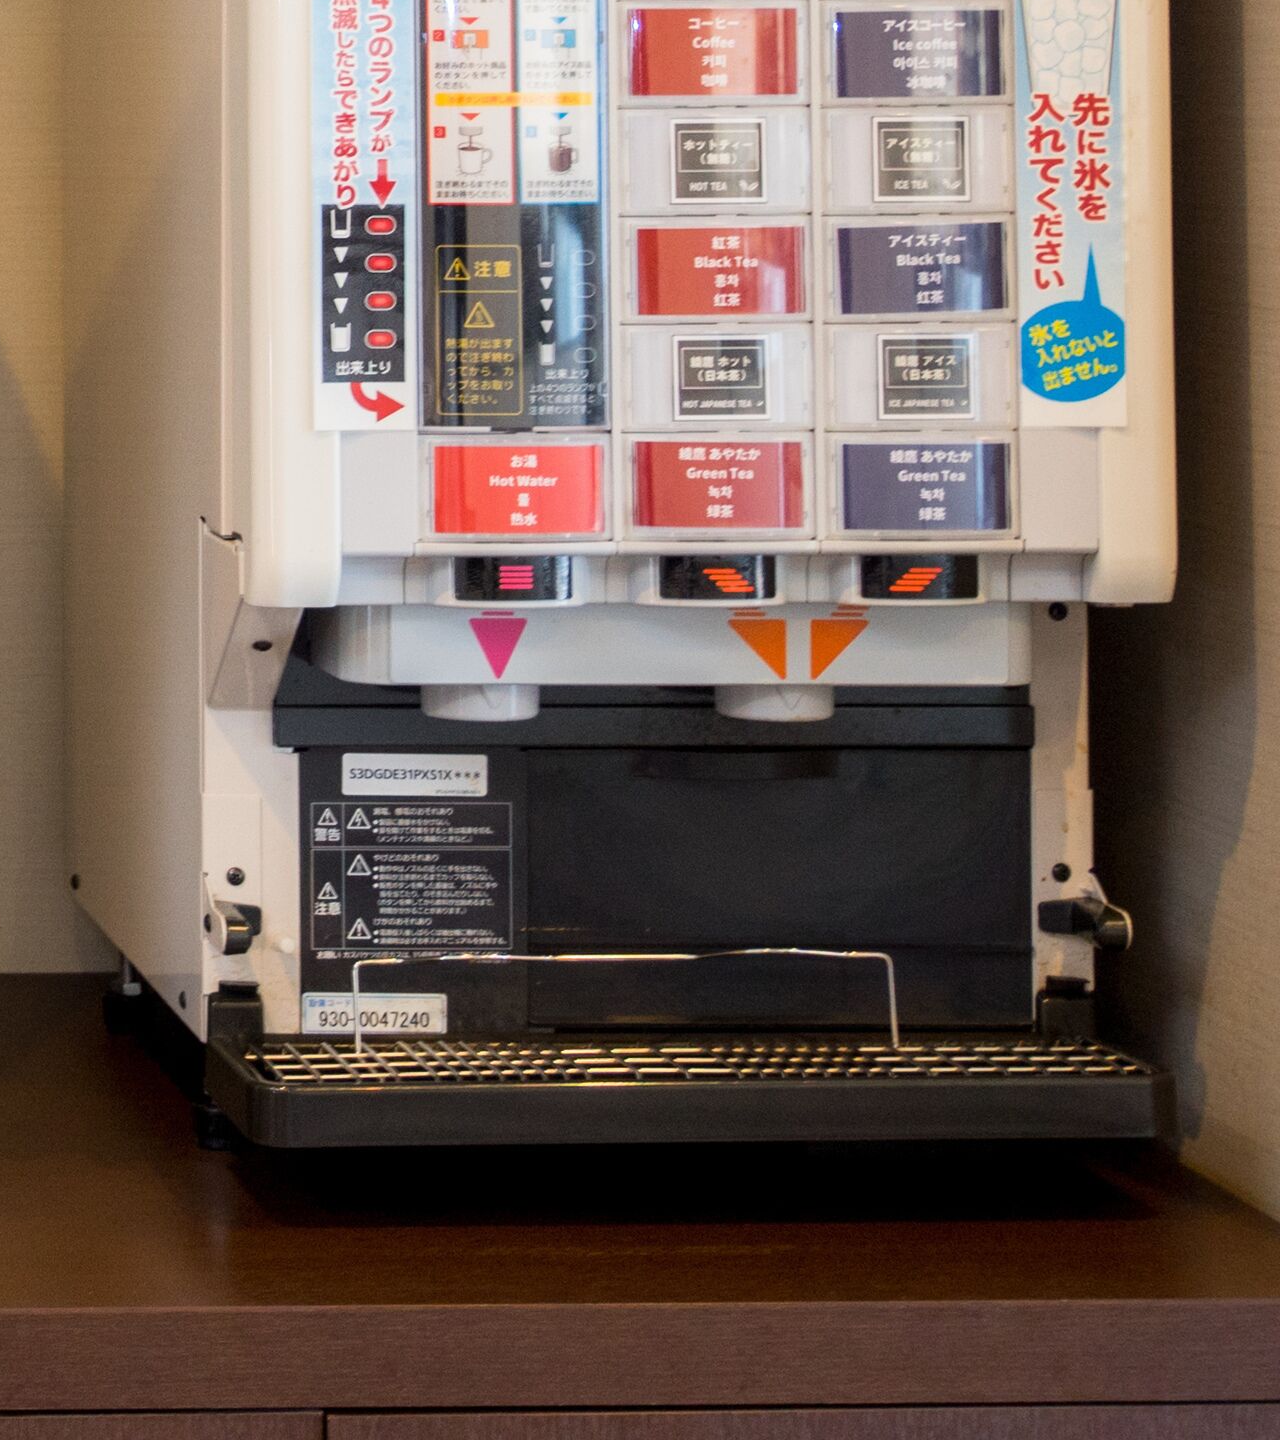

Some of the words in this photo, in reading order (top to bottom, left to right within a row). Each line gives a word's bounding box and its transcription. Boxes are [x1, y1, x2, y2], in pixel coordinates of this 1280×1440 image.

[688, 17, 739, 30] コーヒー
[882, 20, 966, 33] アイスコーヒー
[692, 36, 736, 49] Coffee
[893, 40, 913, 51] Ice
[916, 39, 957, 51] coffee
[683, 140, 754, 151] ホットティー
[886, 138, 955, 149] アイスティー
[1072, 94, 1110, 221] 先に氷を
[689, 182, 708, 192] HOT
[710, 181, 727, 191] TEA
[894, 180, 910, 190] ICE
[911, 180, 928, 190] TEA
[1028, 94, 1066, 290] 入れてください
[888, 235, 967, 248] アイスティー
[694, 256, 732, 268] Black
[735, 256, 759, 268] Tea
[896, 254, 934, 266] Black
[937, 253, 961, 264] Tea
[474, 261, 512, 278] 注意
[1029, 319, 1070, 347] 氷を
[1038, 330, 1119, 368] 入れないと
[718, 355, 752, 367] ホット
[923, 355, 957, 366] アイス
[335, 361, 392, 376] 出来上り
[545, 369, 589, 379] 出来上り
[709, 447, 761, 460] あやたか
[920, 450, 973, 463] あやたか
[686, 468, 727, 480] Green
[729, 468, 754, 479] Tea
[898, 470, 939, 482] Green
[941, 470, 966, 482] Tea
[489, 475, 514, 487] Hot
[516, 475, 558, 487] Water
[315, 829, 341, 841] 警告
[315, 902, 341, 916] 注意
[319, 1011, 430, 1027] 930-0047240
